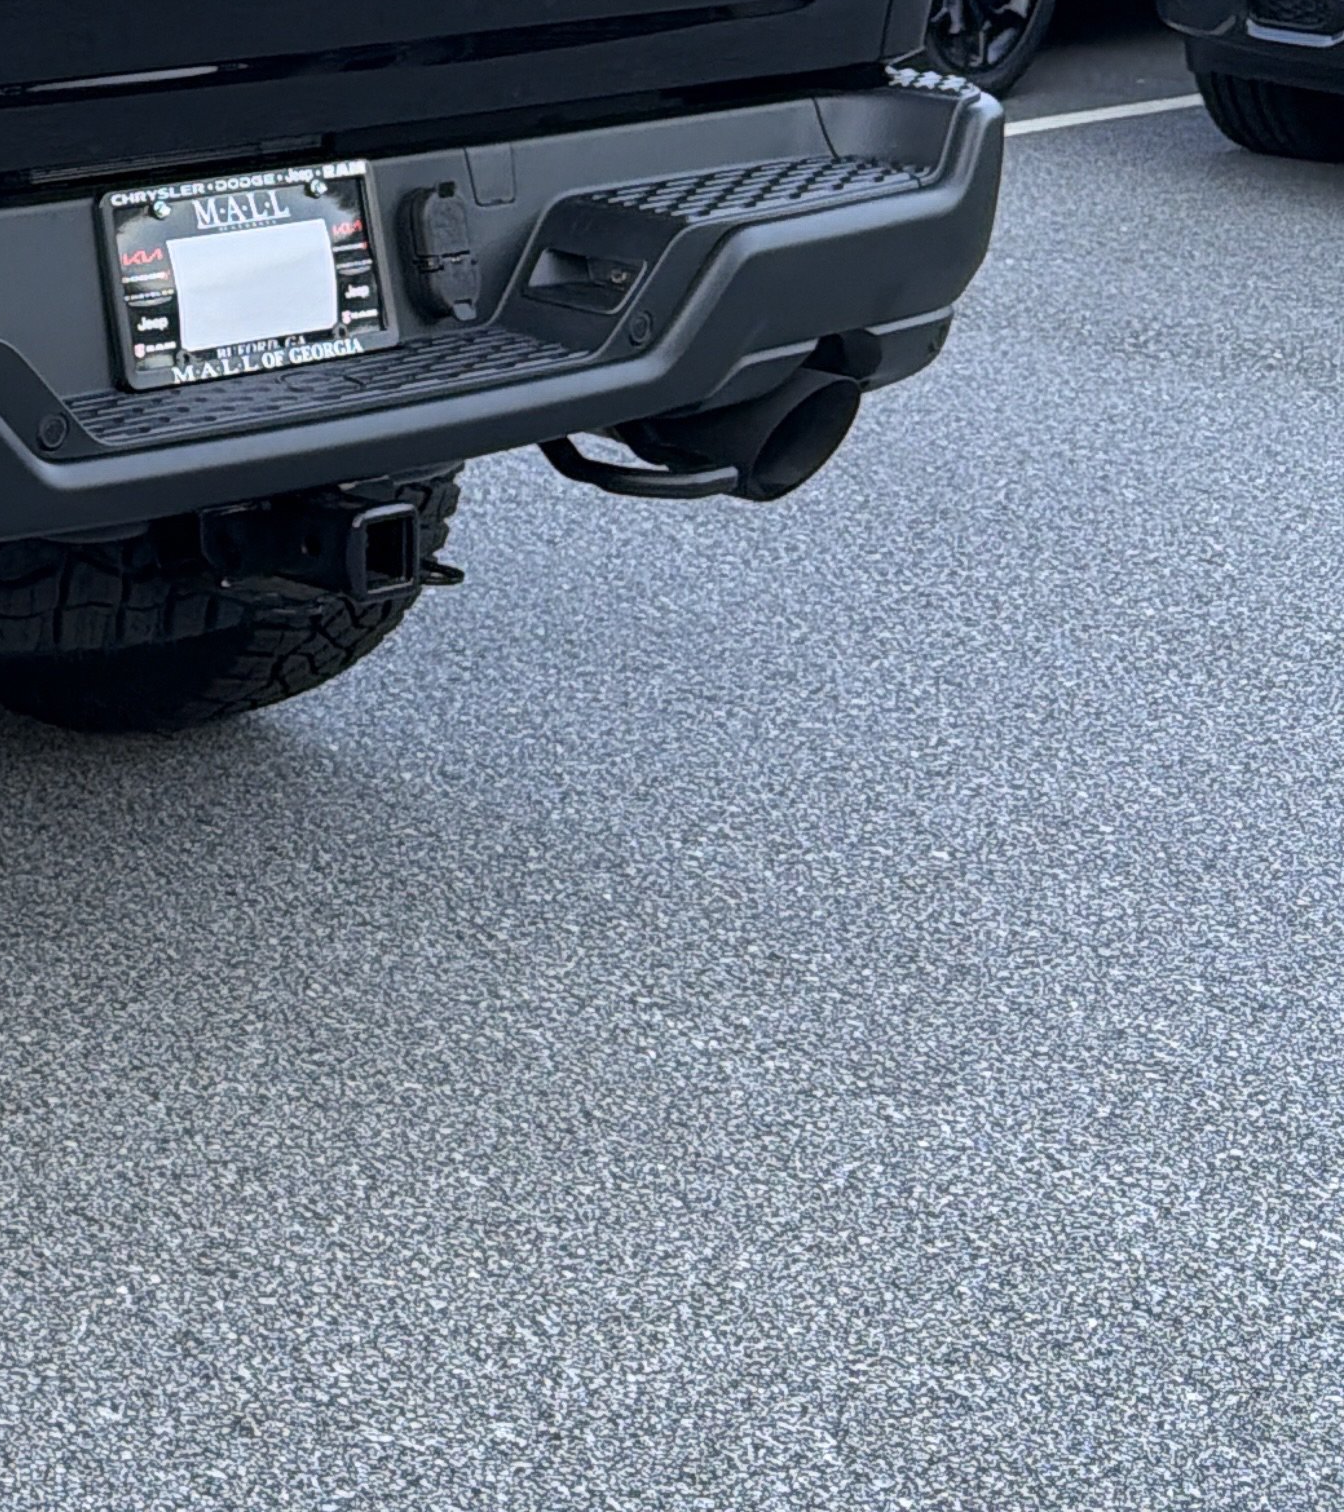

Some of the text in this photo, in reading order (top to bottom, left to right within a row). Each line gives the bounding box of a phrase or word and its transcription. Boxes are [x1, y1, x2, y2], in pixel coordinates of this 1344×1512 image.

[110, 158, 368, 208] CHRYSLER DODGE Jeep RAM
[261, 348, 286, 369] OF
[288, 337, 365, 365] GEORGIA
